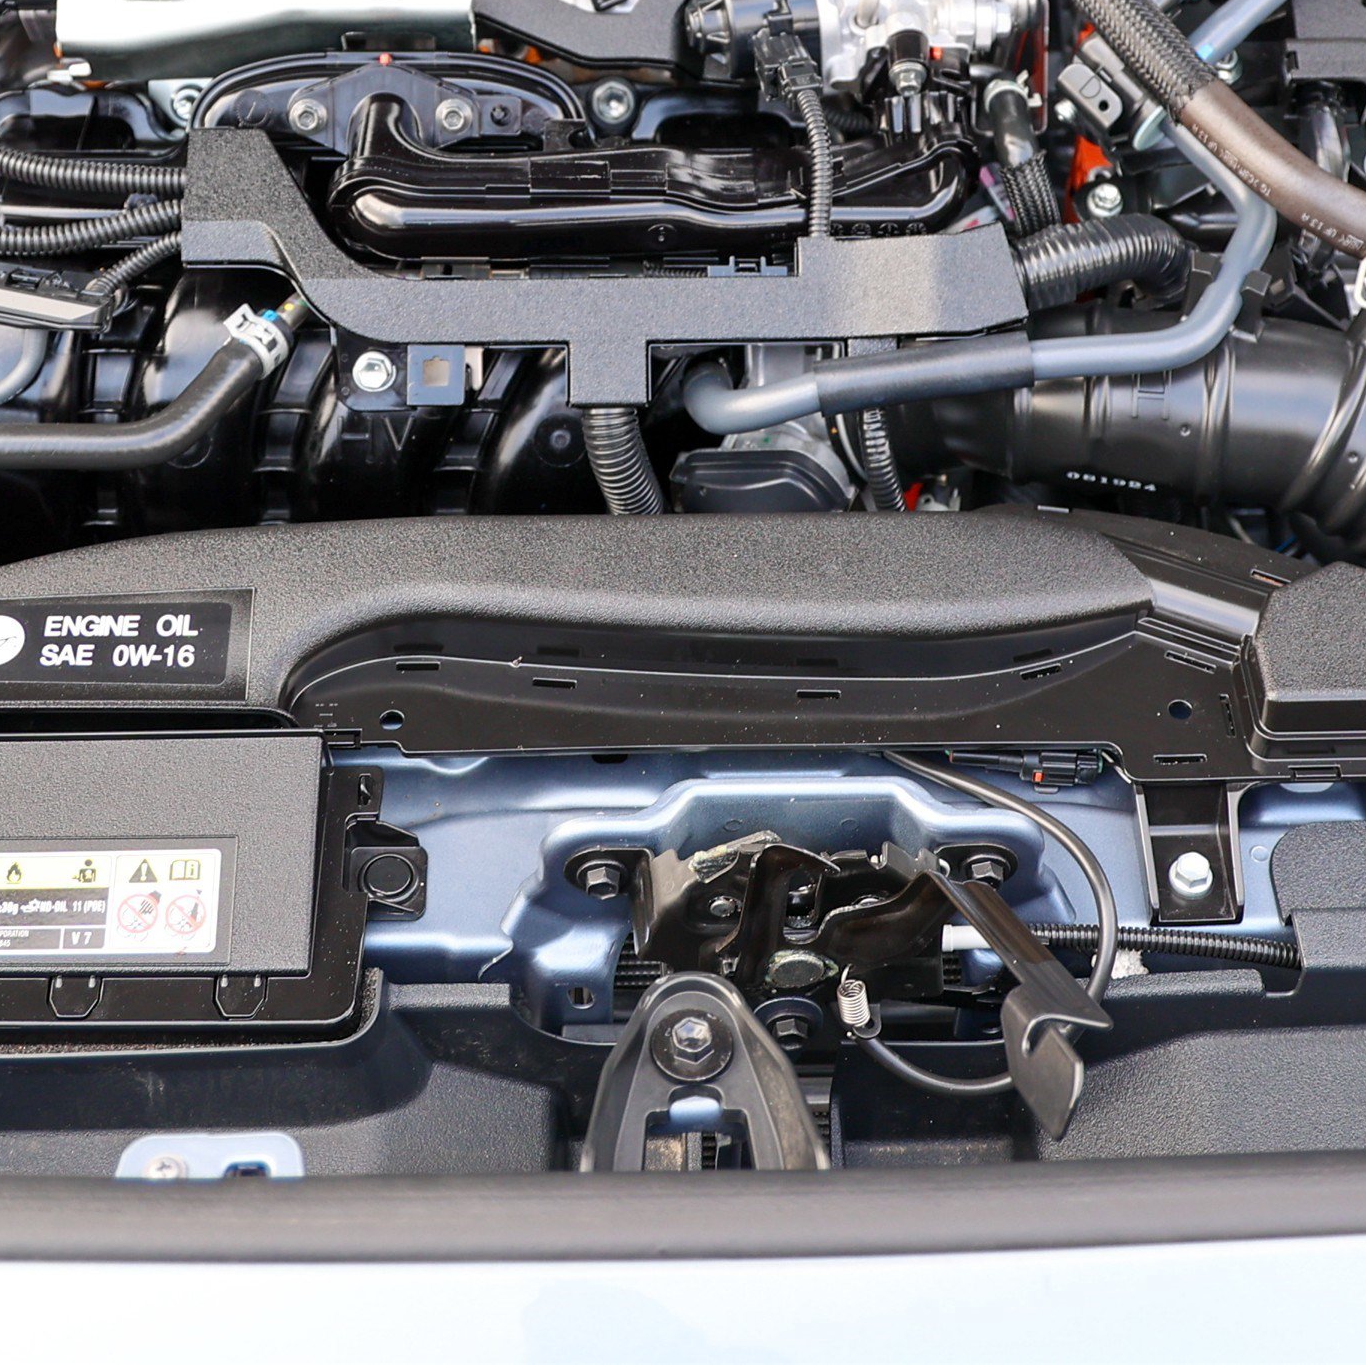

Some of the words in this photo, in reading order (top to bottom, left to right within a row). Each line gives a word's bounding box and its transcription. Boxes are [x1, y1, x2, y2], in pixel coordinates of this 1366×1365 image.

[44, 614, 142, 637] ENGINE
[156, 614, 199, 636] OIL
[39, 644, 95, 667] SAE
[112, 644, 195, 668] 0W-16
[73, 900, 83, 912] 11
[83, 900, 106, 914] (POE)
[71, 932, 80, 945] V
[84, 932, 92, 944] 7
